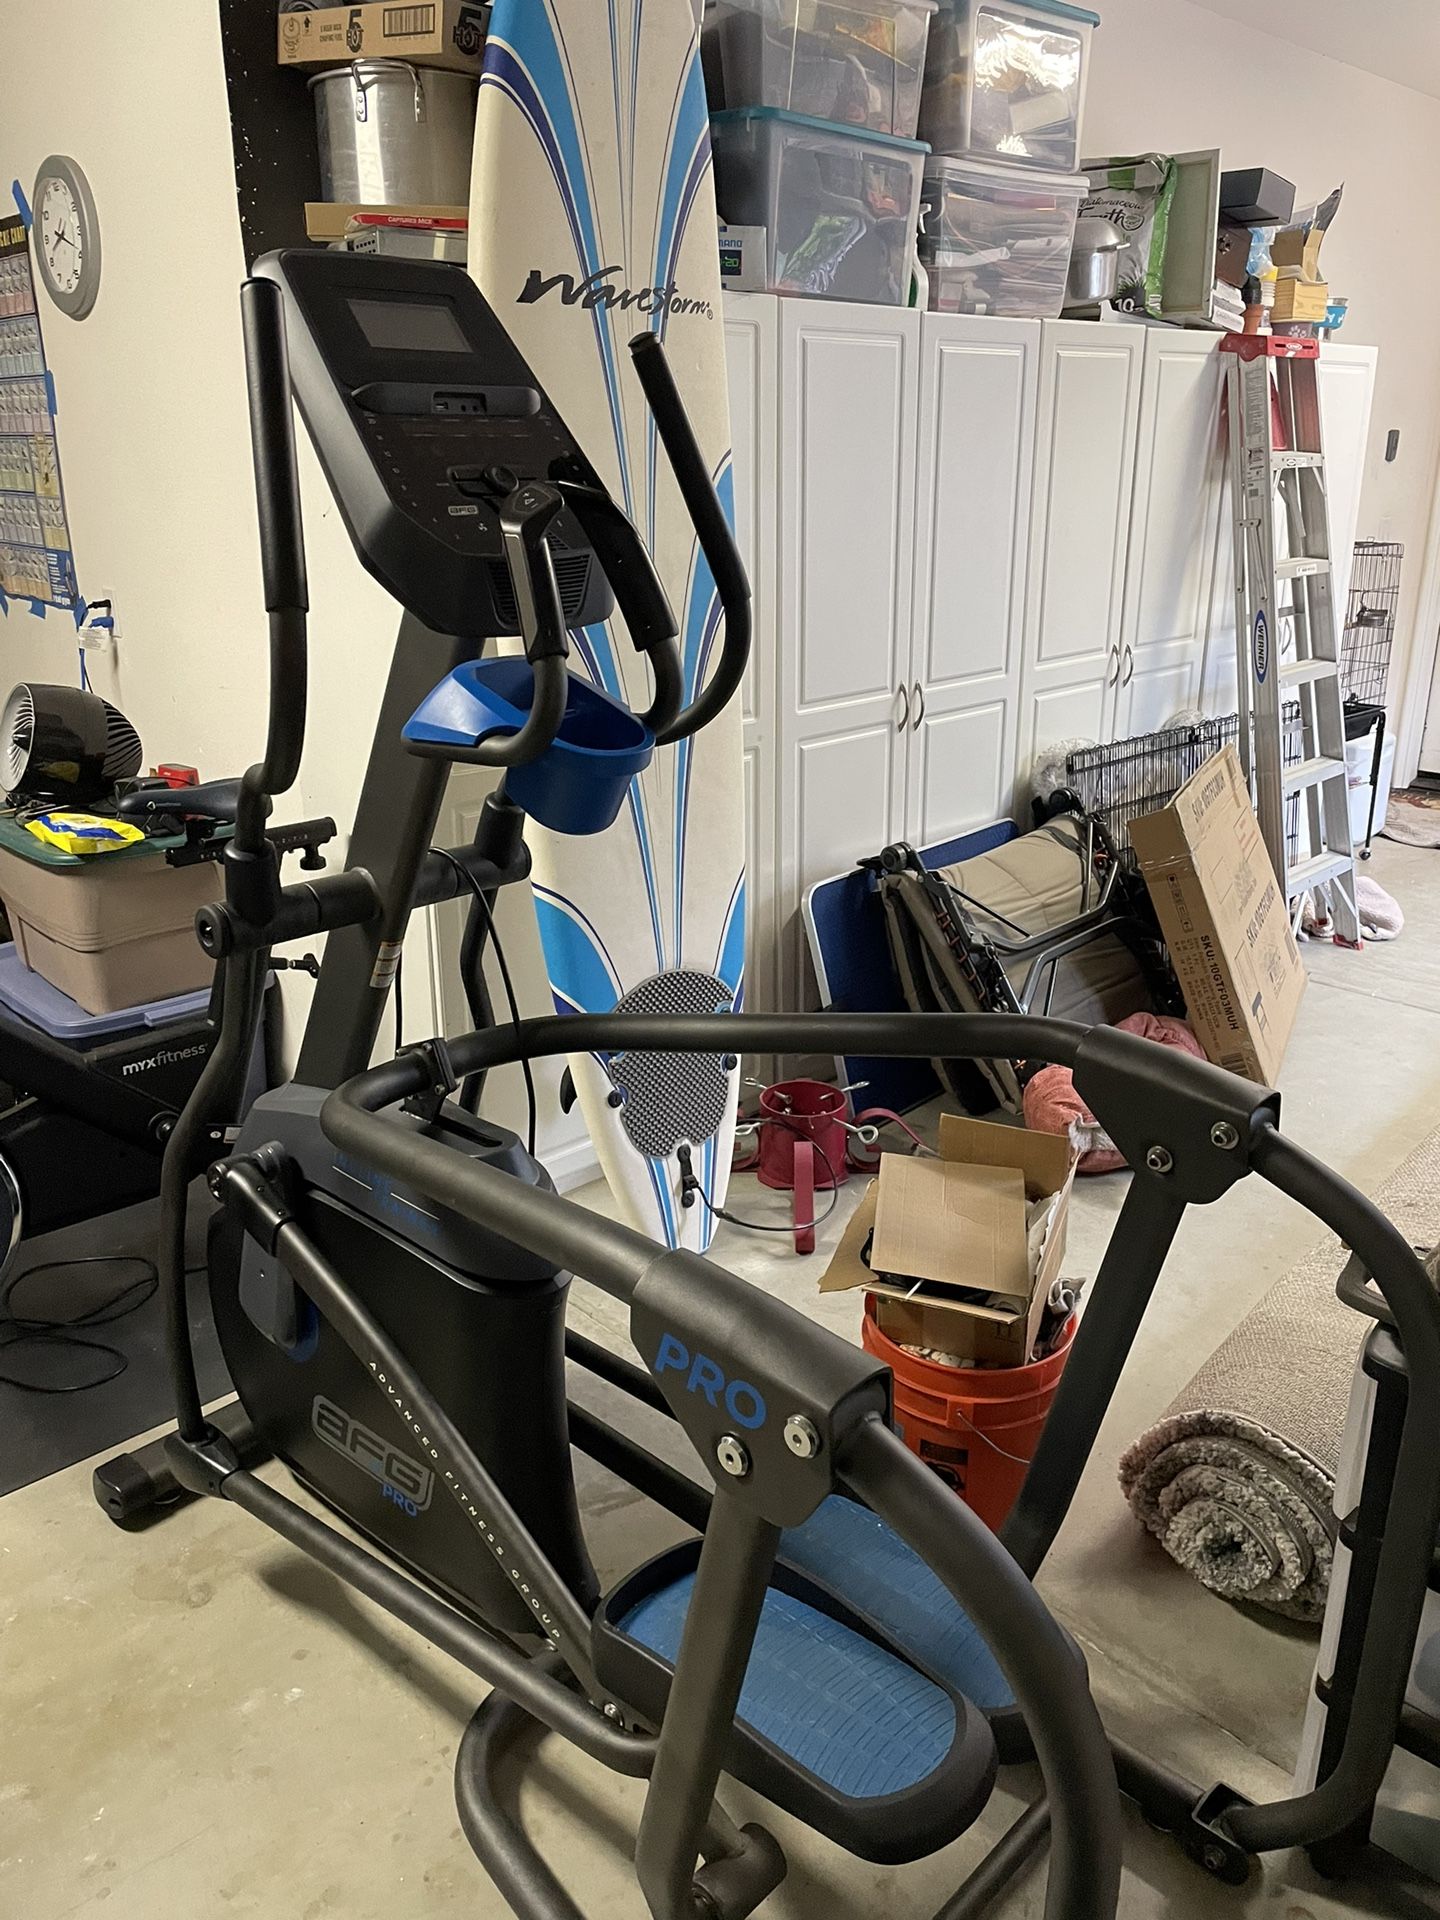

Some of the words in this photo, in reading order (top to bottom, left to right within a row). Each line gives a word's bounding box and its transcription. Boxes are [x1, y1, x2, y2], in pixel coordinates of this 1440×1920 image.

[516, 265, 711, 320] Wavestorm
[1257, 624, 1265, 671] WERNER
[1200, 935, 1216, 962] SKU:
[1210, 962, 1239, 1031] 10GTF03MUH
[122, 1043, 207, 1076] myxfitness
[655, 1331, 767, 1429] PRO
[369, 1362, 438, 1458] ADVANCED
[445, 1471, 504, 1555] FITNESS
[511, 1569, 561, 1638] GROUP
[383, 1483, 418, 1517] PRO
